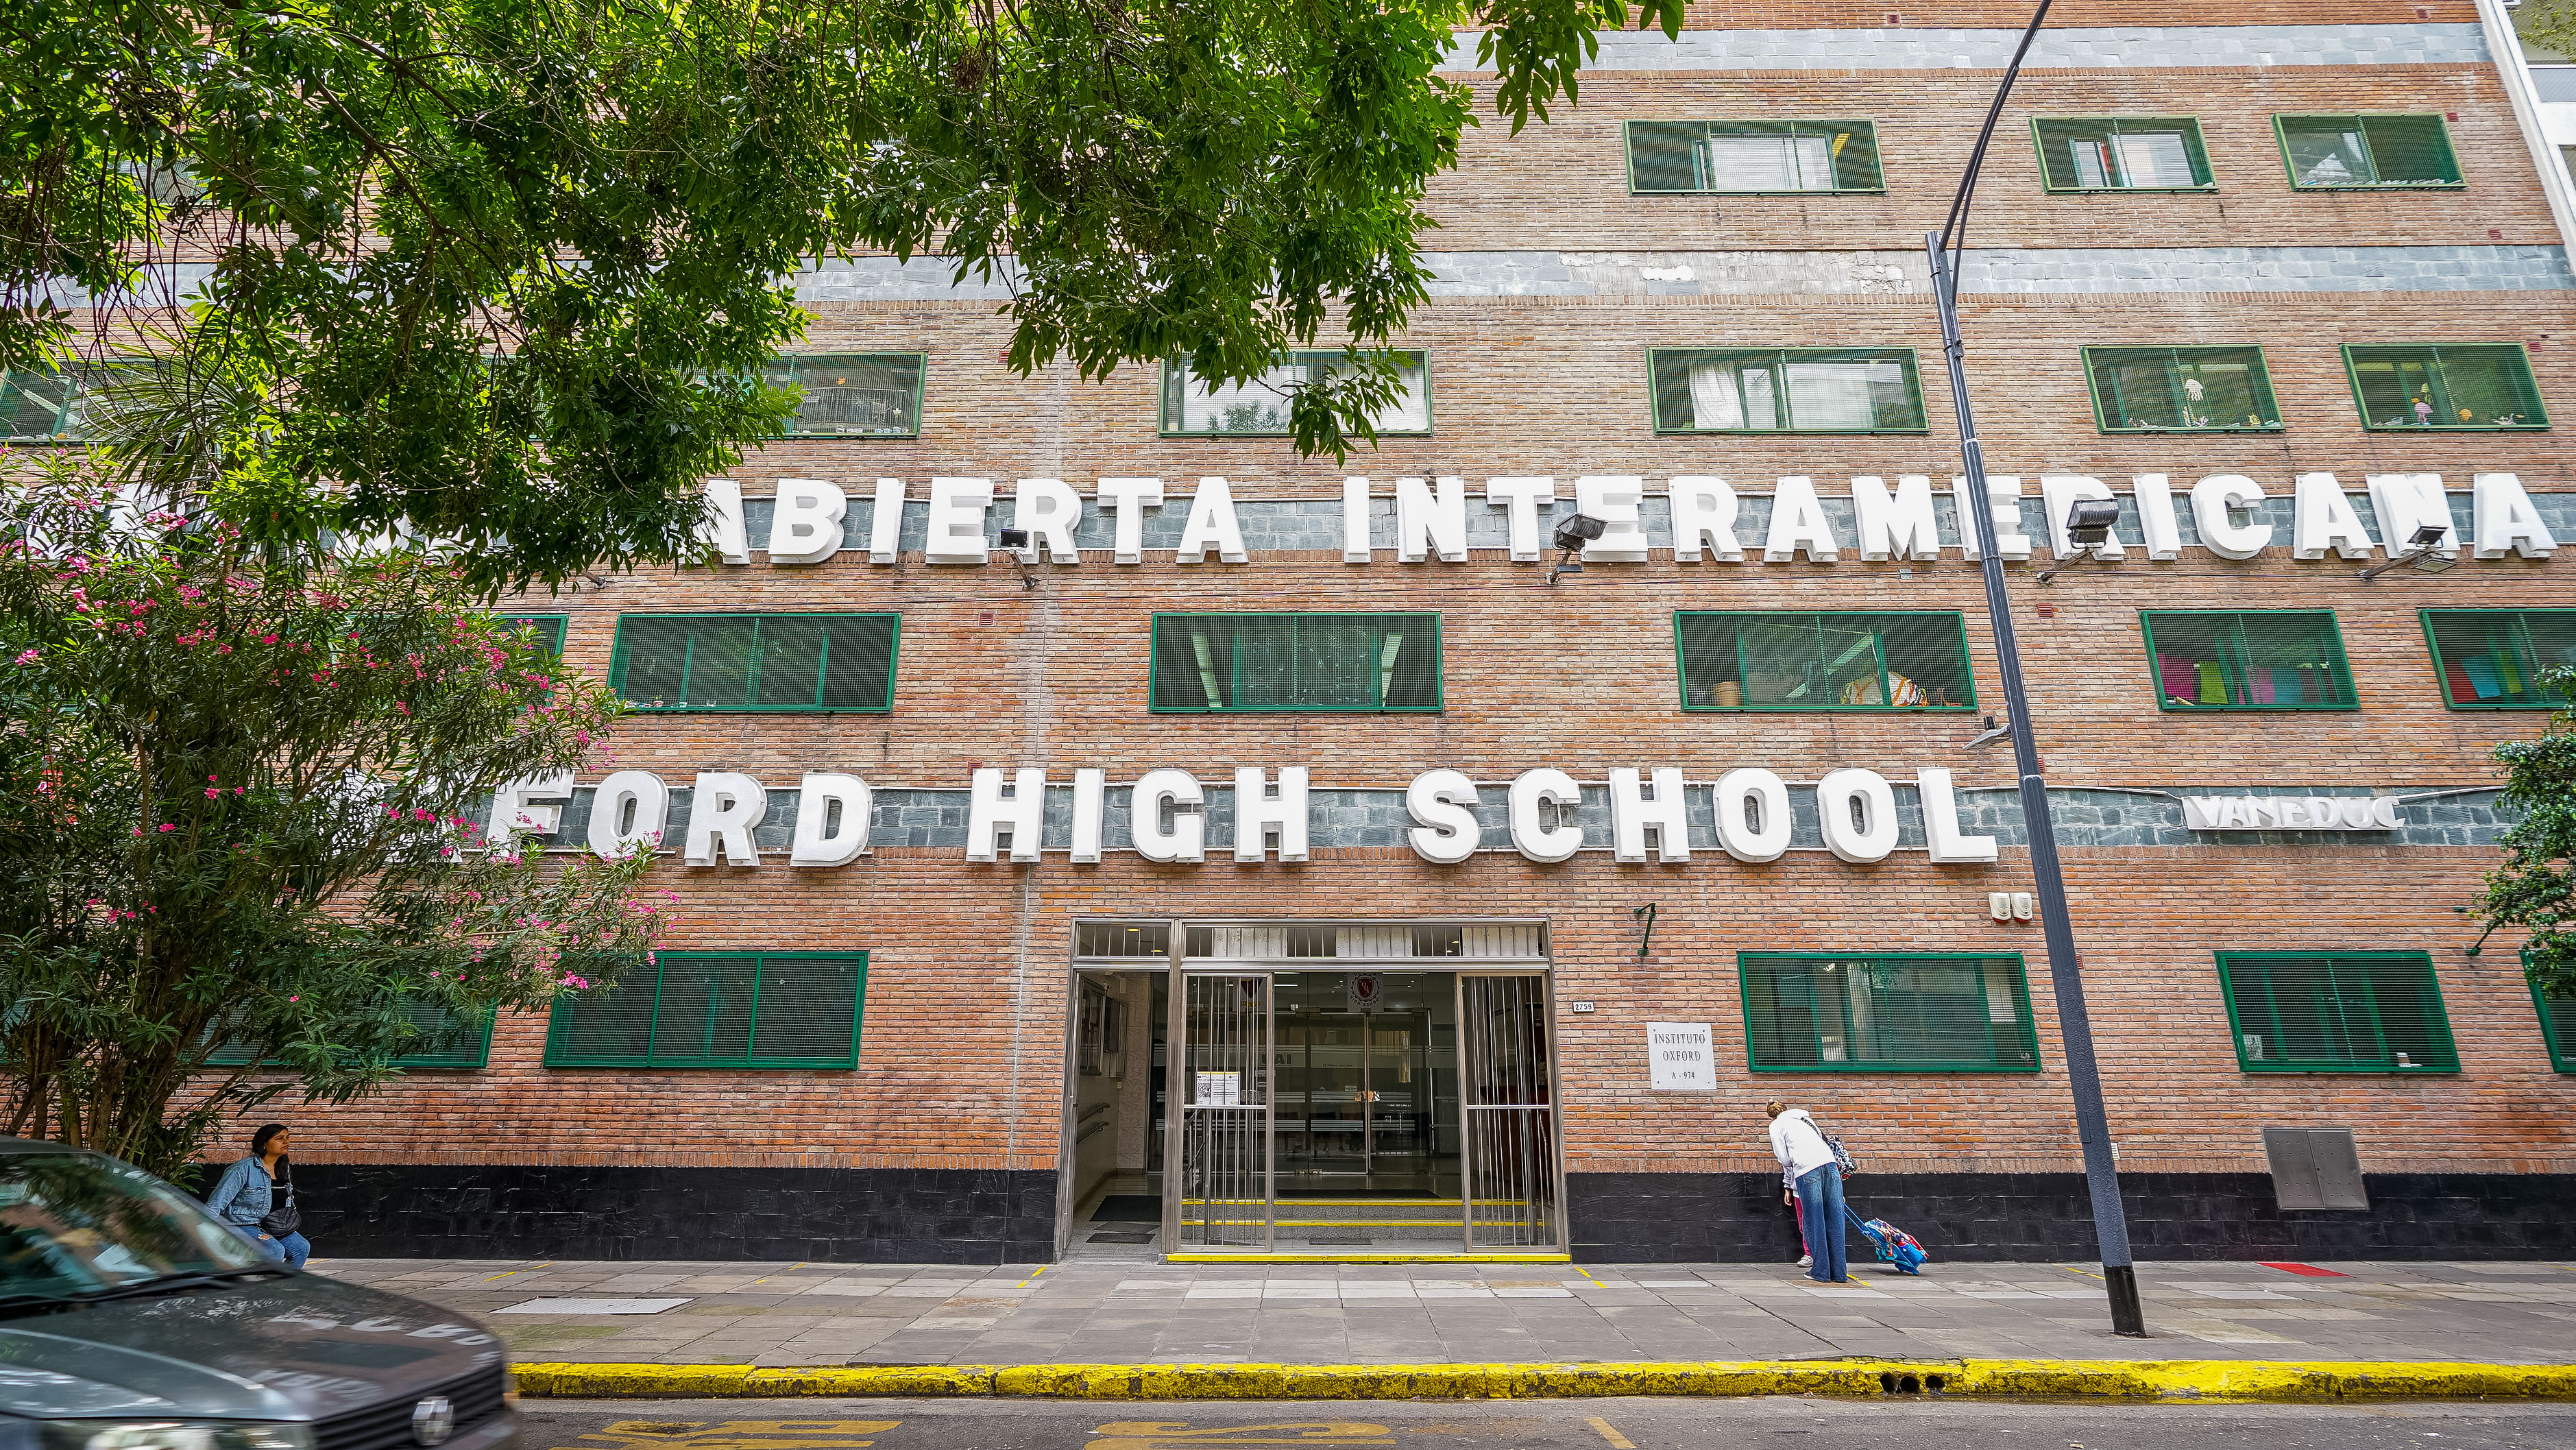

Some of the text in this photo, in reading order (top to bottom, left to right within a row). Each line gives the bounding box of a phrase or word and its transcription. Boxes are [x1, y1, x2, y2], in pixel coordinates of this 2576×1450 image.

[679, 472, 2558, 564] ABIERTA INTERAMERICANA
[312, 766, 1999, 867] FORD HIGH SCHOOL
[2183, 795, 2406, 829] VANEDUC
[1654, 1033, 1705, 1044] INSTITUTO
[1662, 1050, 1701, 1061] OXFORD
[1684, 1071, 1695, 1080] 974
